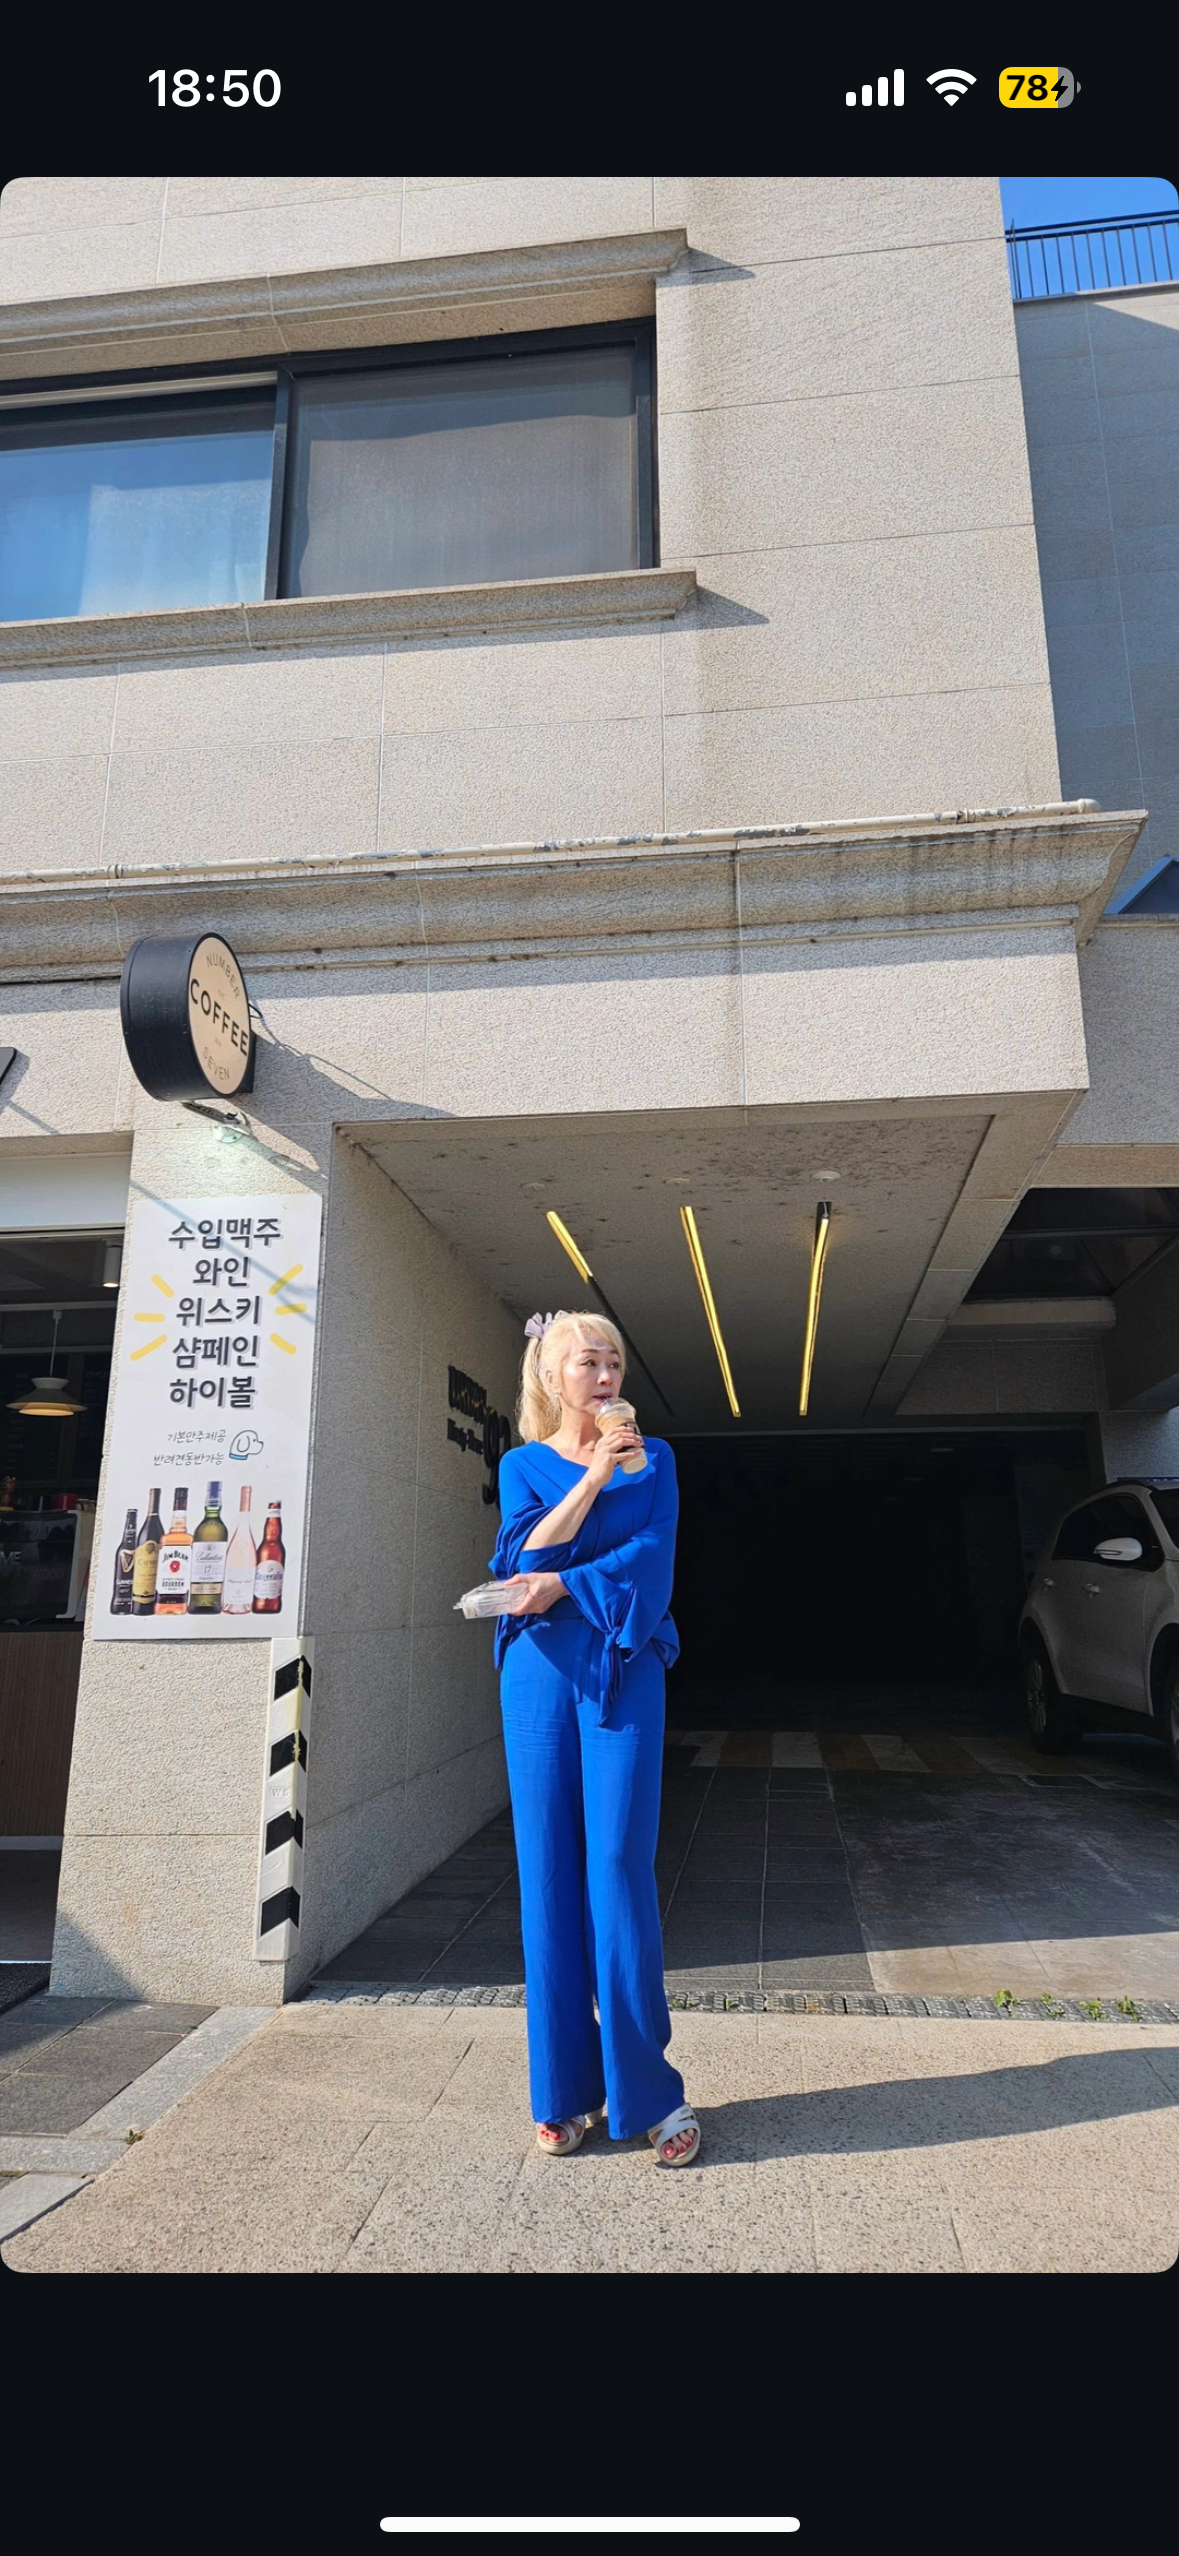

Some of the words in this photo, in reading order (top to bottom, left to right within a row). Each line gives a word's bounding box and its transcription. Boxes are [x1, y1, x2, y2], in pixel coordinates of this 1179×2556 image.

[205, 954, 241, 999] NUMBER
[190, 978, 248, 1057] COFFEE
[202, 1046, 231, 1081] SEVEN
[168, 1218, 282, 1250] 수입맥주
[192, 1256, 249, 1287] 와인
[176, 1295, 261, 1327] 위스키
[172, 1335, 259, 1369] 샴페인
[169, 1376, 256, 1409] 하이볼
